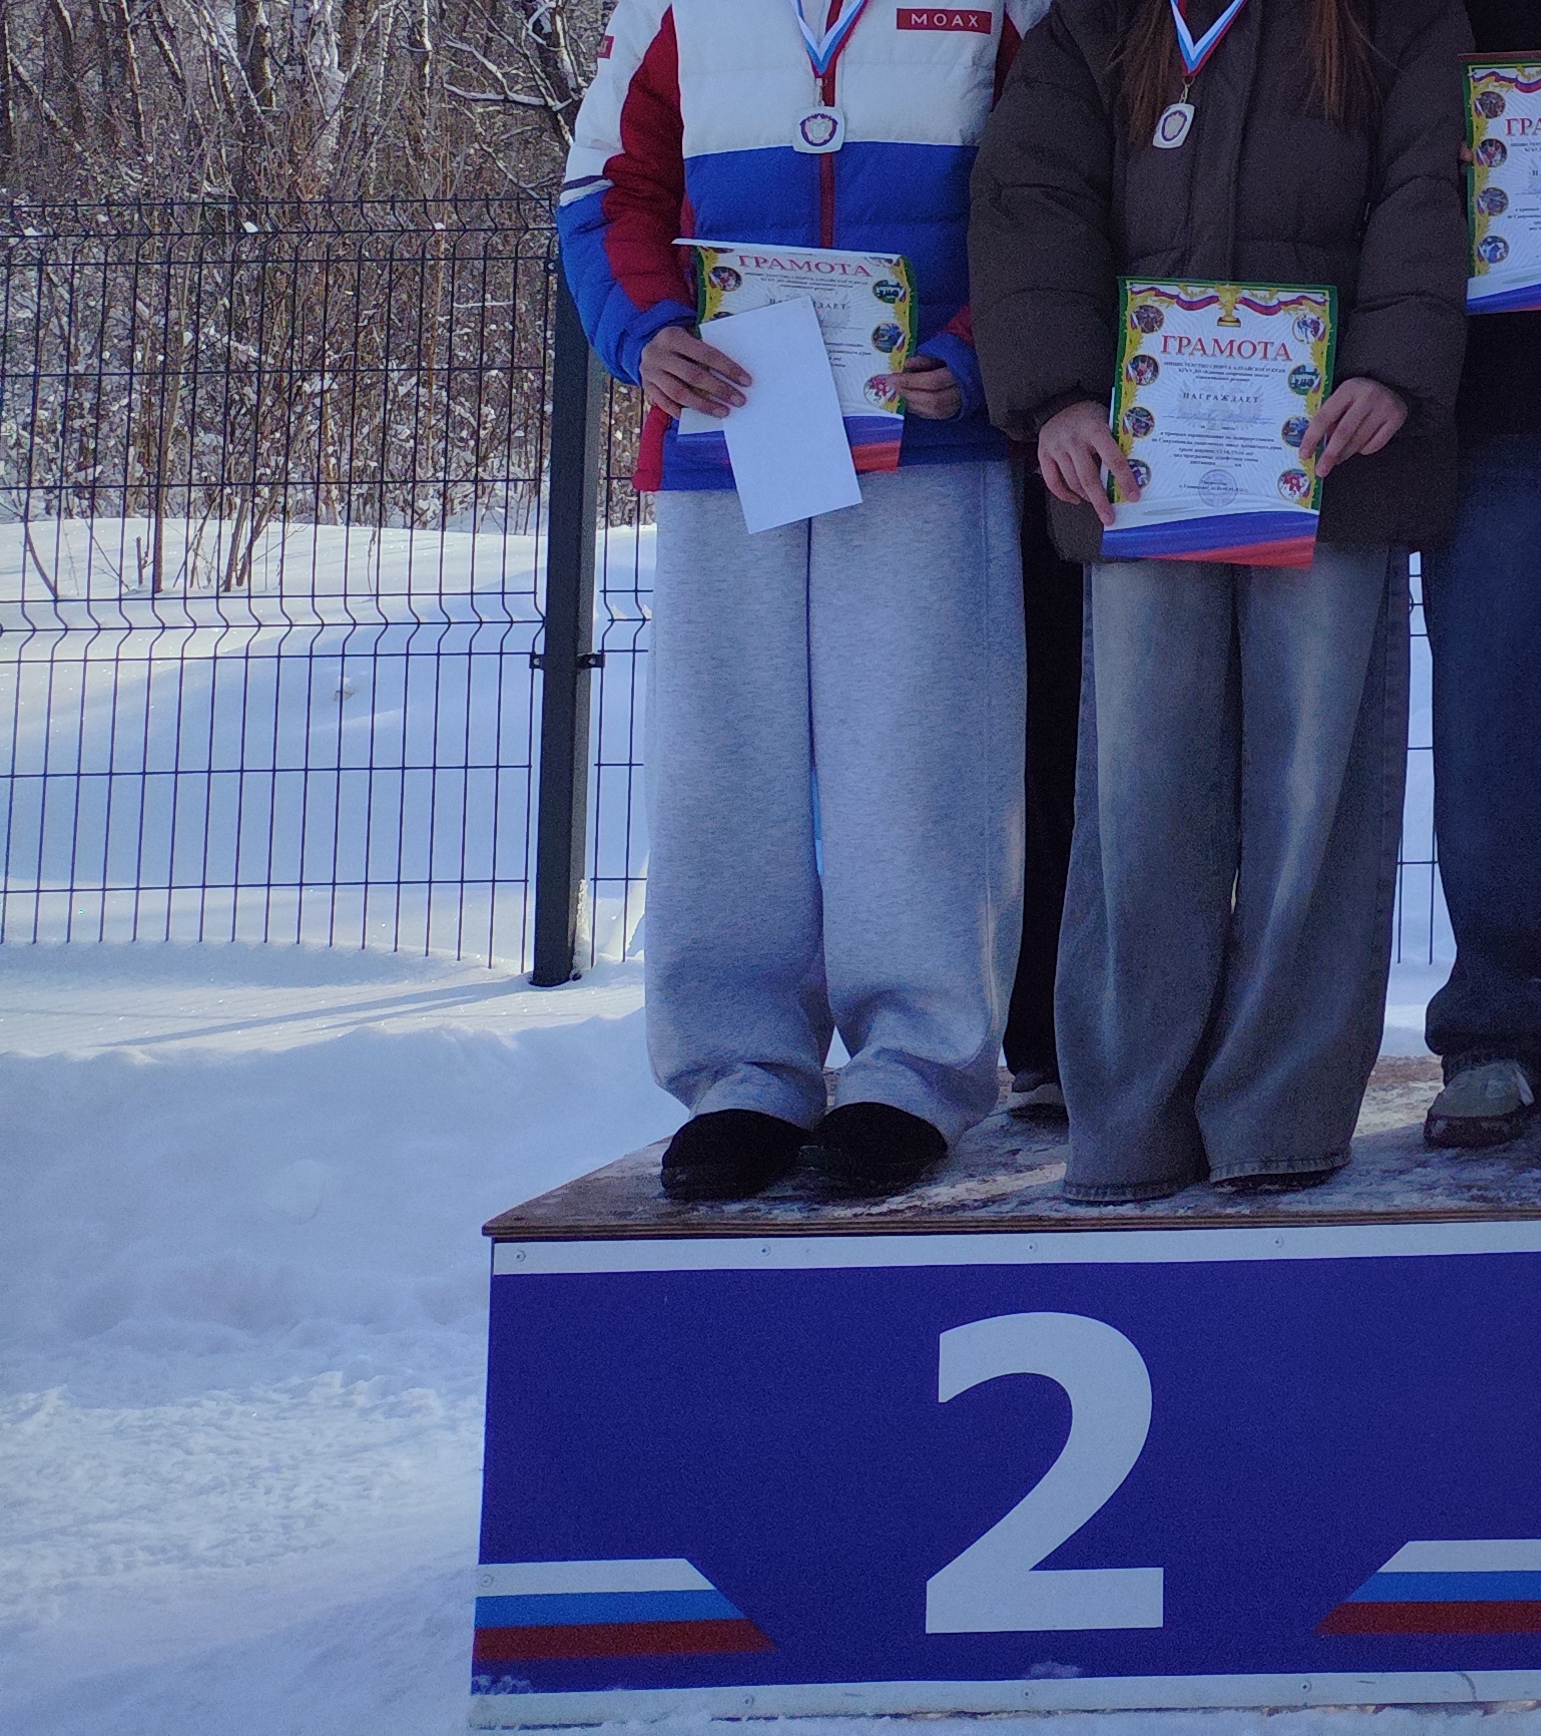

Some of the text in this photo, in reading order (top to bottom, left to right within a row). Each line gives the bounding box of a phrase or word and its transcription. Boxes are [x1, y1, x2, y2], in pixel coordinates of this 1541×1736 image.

[910, 13, 979, 28] MOAX
[736, 254, 873, 277] ГРАМОТА
[1160, 334, 1293, 362] ГРАМОТА
[1182, 392, 1260, 404] НАГРАЖДАЕТ
[925, 1311, 1164, 1633] 2
